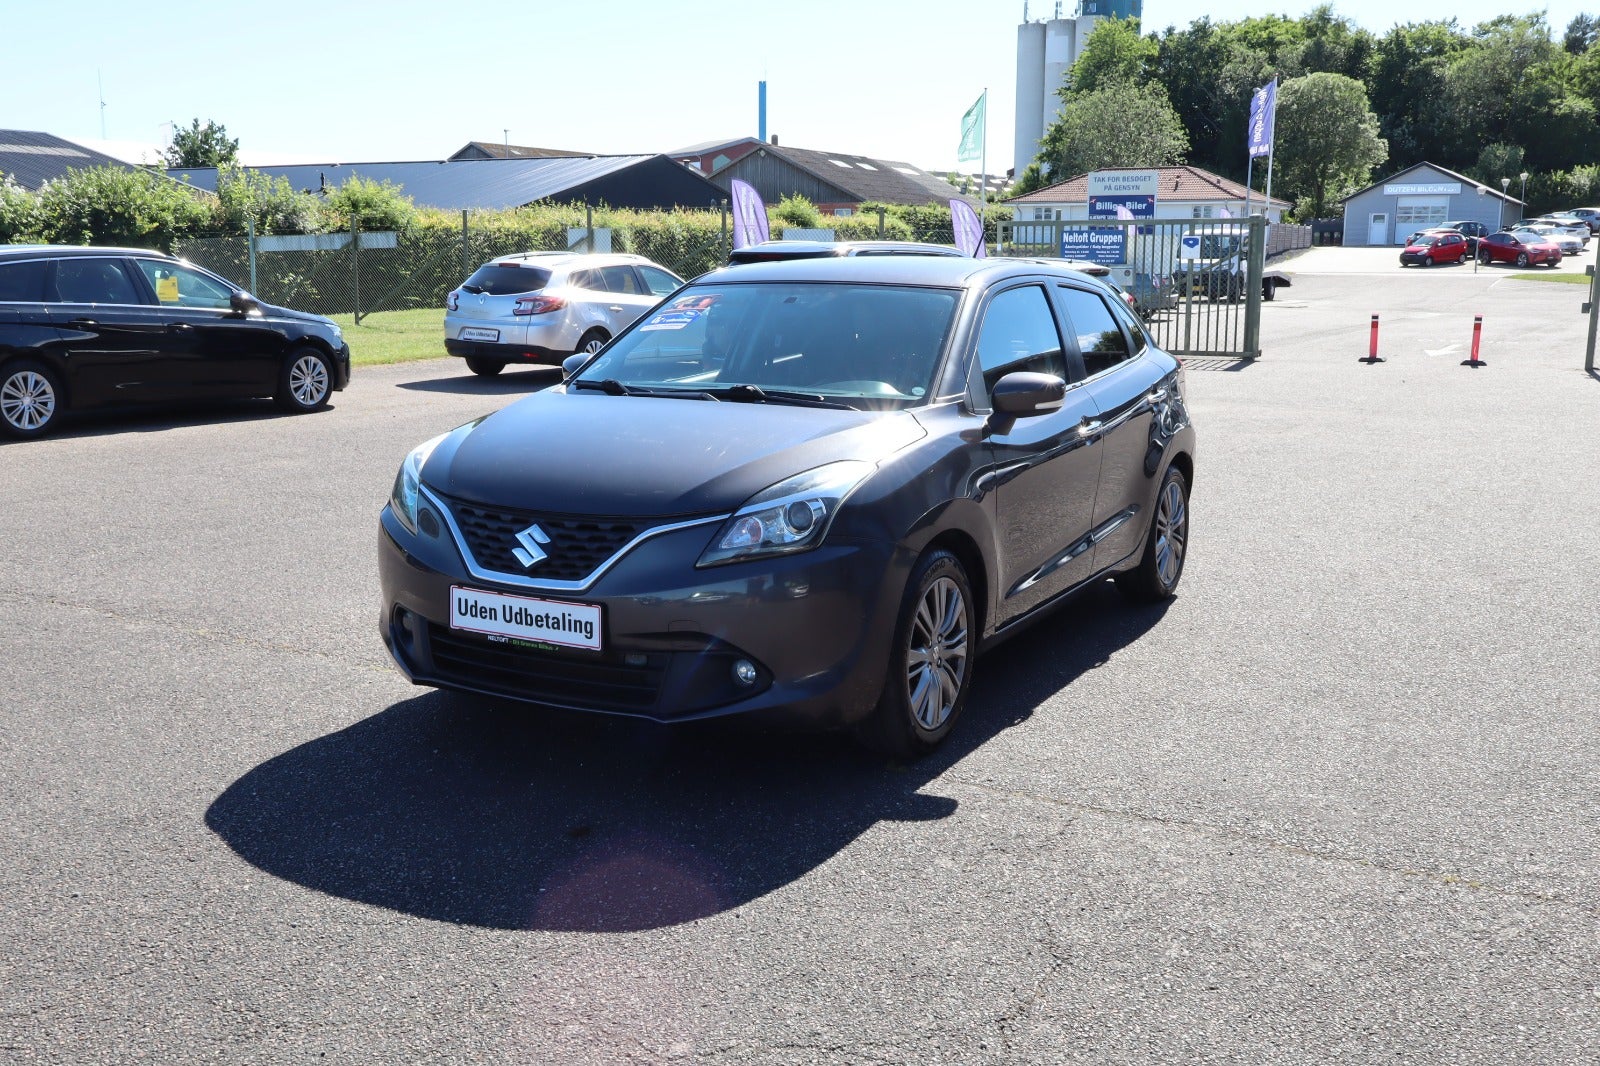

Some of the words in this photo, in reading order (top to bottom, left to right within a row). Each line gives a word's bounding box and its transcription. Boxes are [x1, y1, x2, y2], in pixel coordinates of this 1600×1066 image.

[1096, 202, 1120, 211] Billig
[1126, 201, 1147, 210] Biler
[1063, 231, 1089, 243] Neltoft
[1089, 231, 1123, 245] Gruppen
[457, 597, 498, 621] Uden
[502, 604, 594, 640] Udbetaling
